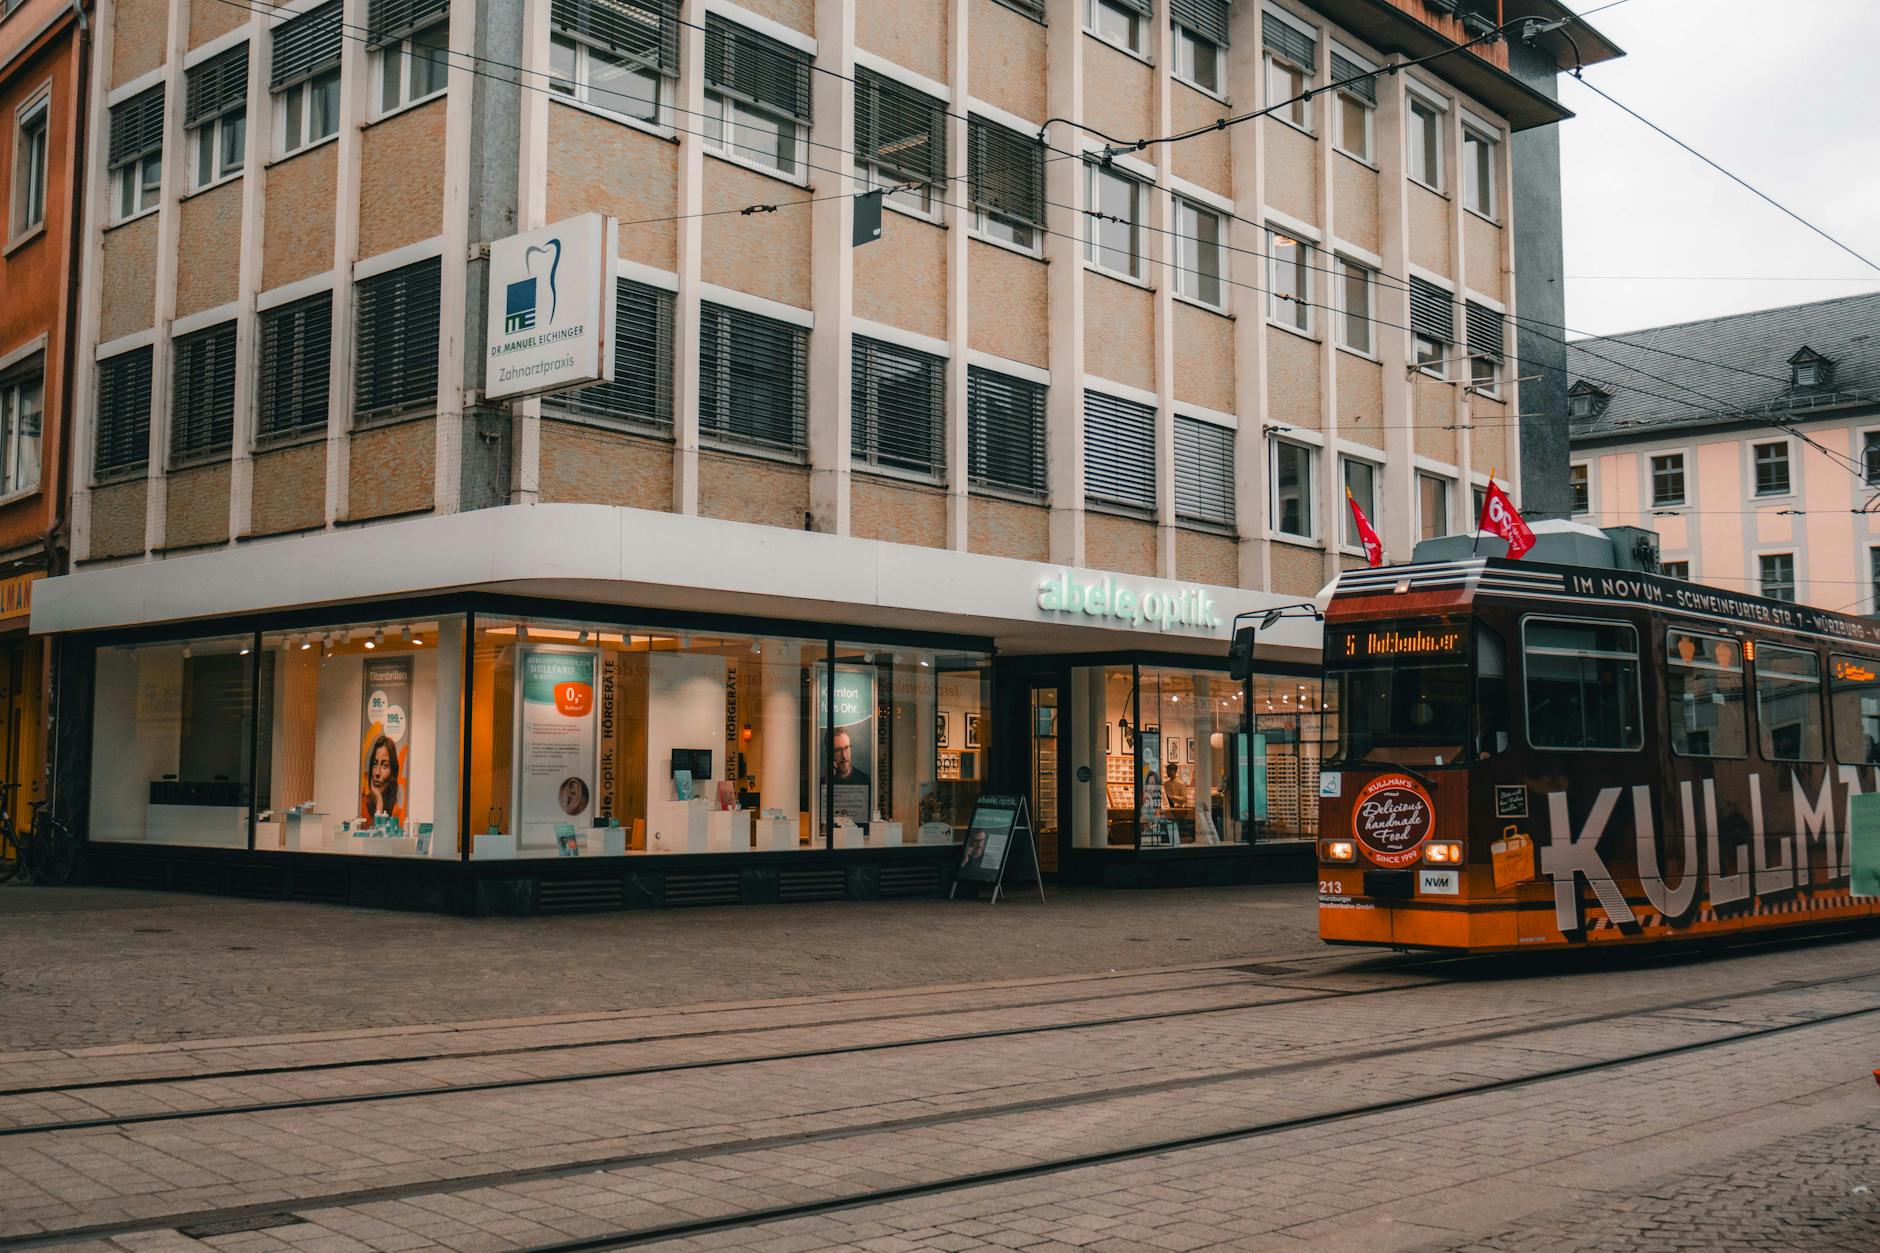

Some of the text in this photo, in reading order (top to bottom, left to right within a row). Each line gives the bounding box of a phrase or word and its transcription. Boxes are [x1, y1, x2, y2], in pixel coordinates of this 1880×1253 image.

[539, 325, 584, 344] EICHINGER
[500, 353, 575, 382] Zahnarztpraxis
[1038, 570, 1224, 632] abele,optik.
[1573, 575, 1594, 594] IM
[1602, 578, 1663, 602] NOVUM
[1676, 590, 1771, 622] SCHWEINFURTER
[1772, 608, 1796, 626] STR.
[1813, 615, 1864, 639] WÜRZBURG
[601, 660, 615, 739] HÖRGERÄTE
[821, 686, 858, 699] Kmfort
[727, 667, 738, 742] HÖRGERÄTE
[1368, 778, 1412, 793] KULLMAN'S
[1362, 799, 1423, 817] Delicious
[1365, 811, 1421, 830] handmade
[1373, 826, 1410, 843] Food
[1376, 851, 1417, 863] SINCE 1999
[1320, 881, 1342, 893] 213
[1424, 877, 1449, 887] NVM
